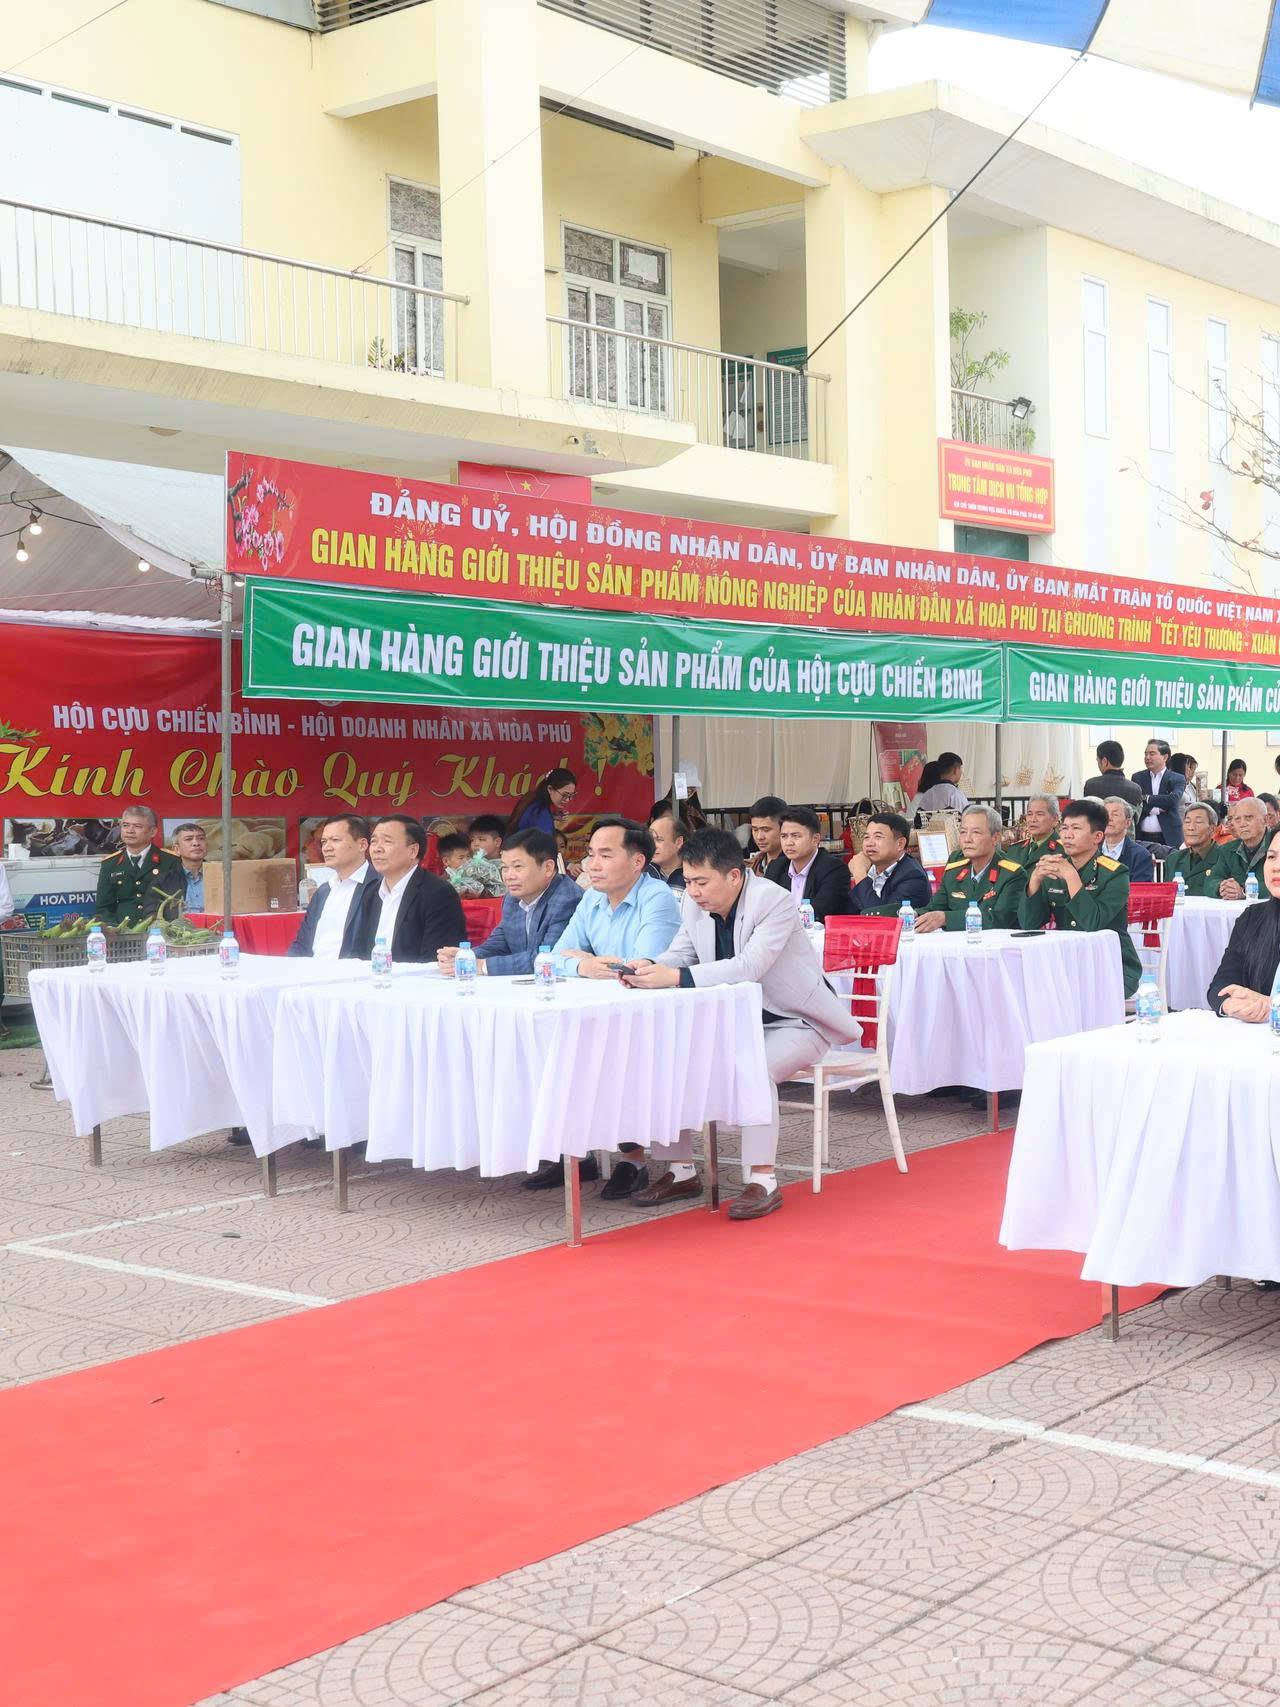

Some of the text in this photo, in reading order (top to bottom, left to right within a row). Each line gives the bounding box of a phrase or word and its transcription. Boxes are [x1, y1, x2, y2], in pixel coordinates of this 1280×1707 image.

[948, 472, 971, 493] TRUNG
[972, 474, 987, 496] TÂM
[988, 479, 1005, 501] DỊCH
[1006, 482, 1015, 504] VỤ
[1015, 479, 1034, 503] TỔNG
[370, 489, 461, 526] ĐẢNG
[472, 504, 519, 536] UỶ,
[529, 512, 577, 544] HỘI
[586, 520, 661, 552] ĐỒNG
[670, 535, 740, 561] NHÂN
[748, 542, 802, 569] DÂN,
[811, 546, 838, 571] ỦY
[845, 555, 888, 577] BAN
[896, 560, 950, 584] NHÂN
[957, 567, 1000, 591] DÂN,
[1006, 568, 1029, 592] ỦY
[1034, 578, 1069, 597] BAN
[1074, 581, 1108, 605] MẶT
[1113, 587, 1151, 609] TRẬN
[1156, 586, 1174, 609] TỔ
[1176, 594, 1212, 616] QUỐC
[1216, 601, 1242, 621] VIỆT
[1245, 606, 1273, 623] NAM
[311, 527, 376, 570] GIAN
[384, 529, 454, 578] HÀNG
[462, 543, 509, 584] GIỚI
[516, 551, 580, 596] THIỆU
[586, 553, 632, 596] SẢN
[641, 559, 699, 602] PHẨM
[705, 570, 758, 608] NÔNG
[763, 580, 828, 619] NGHIỆP
[833, 580, 866, 618] CỦA
[871, 588, 916, 621] NHÂN
[920, 591, 951, 624] DÂN
[954, 595, 974, 625] XÃ
[978, 599, 1006, 629] HOÀ
[1010, 602, 1037, 631] PHÚ
[1041, 607, 1061, 638] TẠI
[1064, 608, 1114, 640] CHƯƠNG
[1118, 615, 1151, 643] TRÌNH
[1182, 621, 1201, 648] YÊU
[1204, 626, 1243, 653] THƯƠNG
[1251, 630, 1276, 656] XUÂN
[291, 623, 983, 703] GIAN HÀNG GIỚI THIỆU SẢN PHẨM CỦA HỘI CỰU CHIẾN BINH
[1029, 671, 1069, 703] GIAN
[1074, 669, 1115, 705] HÀNG
[1122, 673, 1151, 706] GIỚI
[1155, 676, 1194, 715] THIỆU
[1197, 675, 1226, 712] SẢN
[1227, 675, 1263, 714] PHẨM
[53, 701, 95, 734] HỘI
[102, 705, 149, 735] CỰU
[157, 703, 223, 733] CHIẾN
[301, 711, 335, 742] HỘI
[341, 715, 406, 739] DOANH
[413, 716, 464, 741] NHÂN
[470, 717, 493, 741] XÃ
[498, 717, 533, 742] HÒA
[538, 719, 572, 743] PHÚ
[0, 743, 152, 797] Kính
[169, 749, 304, 798] Chào
[323, 751, 417, 808] Quý
[431, 754, 568, 798] Khá
